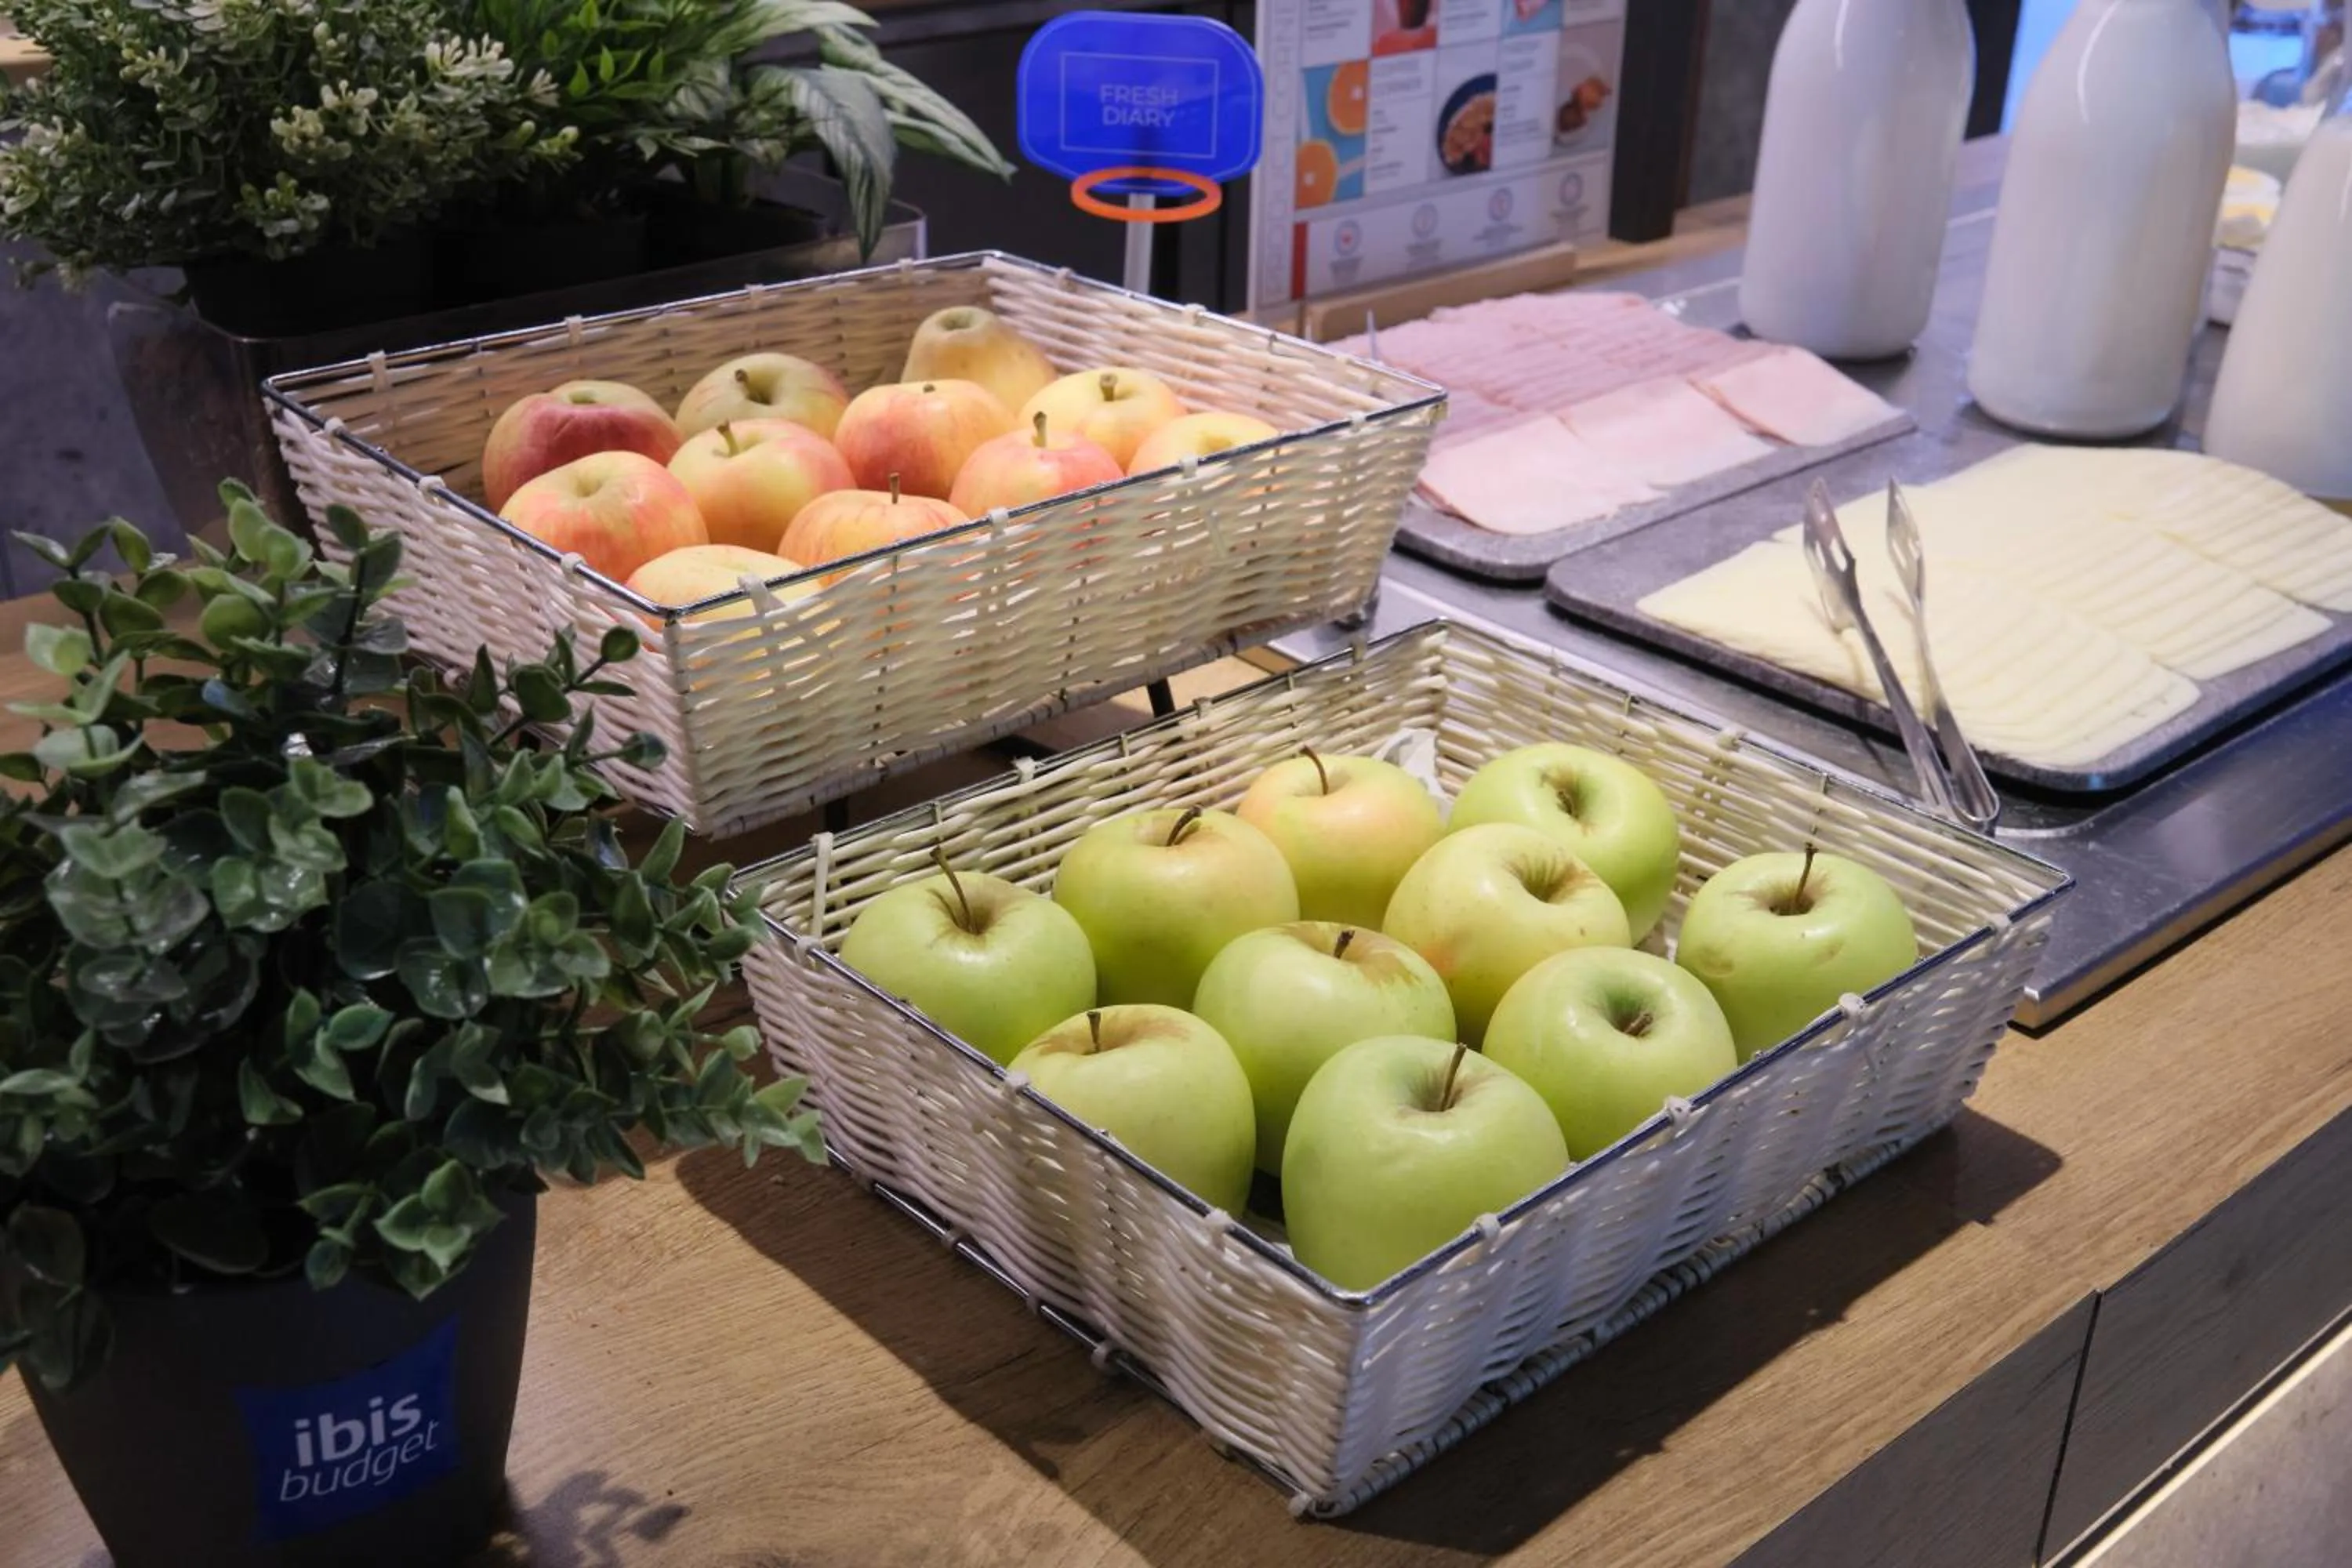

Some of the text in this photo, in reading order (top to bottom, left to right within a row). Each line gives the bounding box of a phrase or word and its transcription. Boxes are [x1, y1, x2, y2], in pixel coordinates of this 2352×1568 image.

[1101, 84, 1178, 106] FRESH
[1103, 107, 1176, 127] DIARY
[295, 1393, 422, 1468] ibis
[279, 1419, 440, 1501] budget
